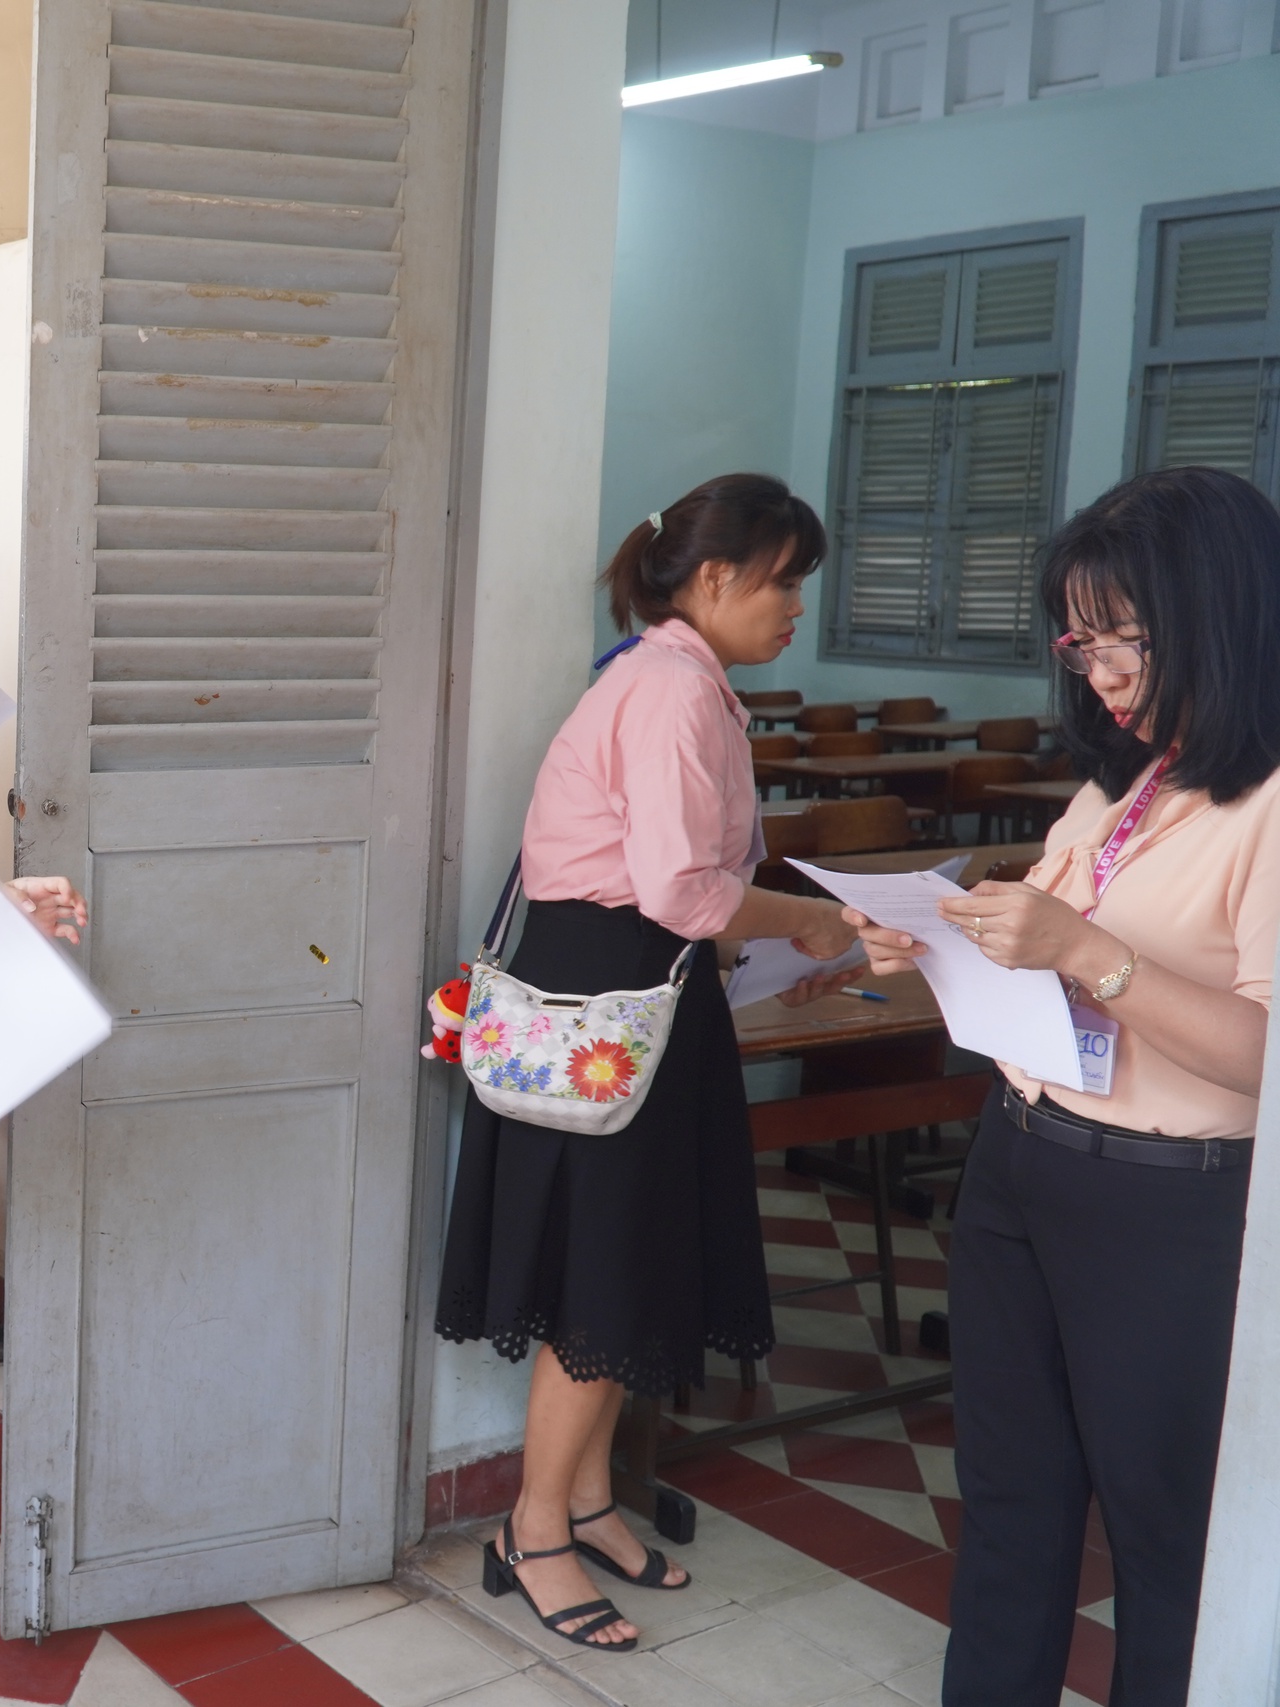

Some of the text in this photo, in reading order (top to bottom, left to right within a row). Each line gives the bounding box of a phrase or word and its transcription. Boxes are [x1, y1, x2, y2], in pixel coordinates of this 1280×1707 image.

[1096, 778, 1160, 875] LOVE LOVE
[1079, 1032, 1109, 1058] 10
